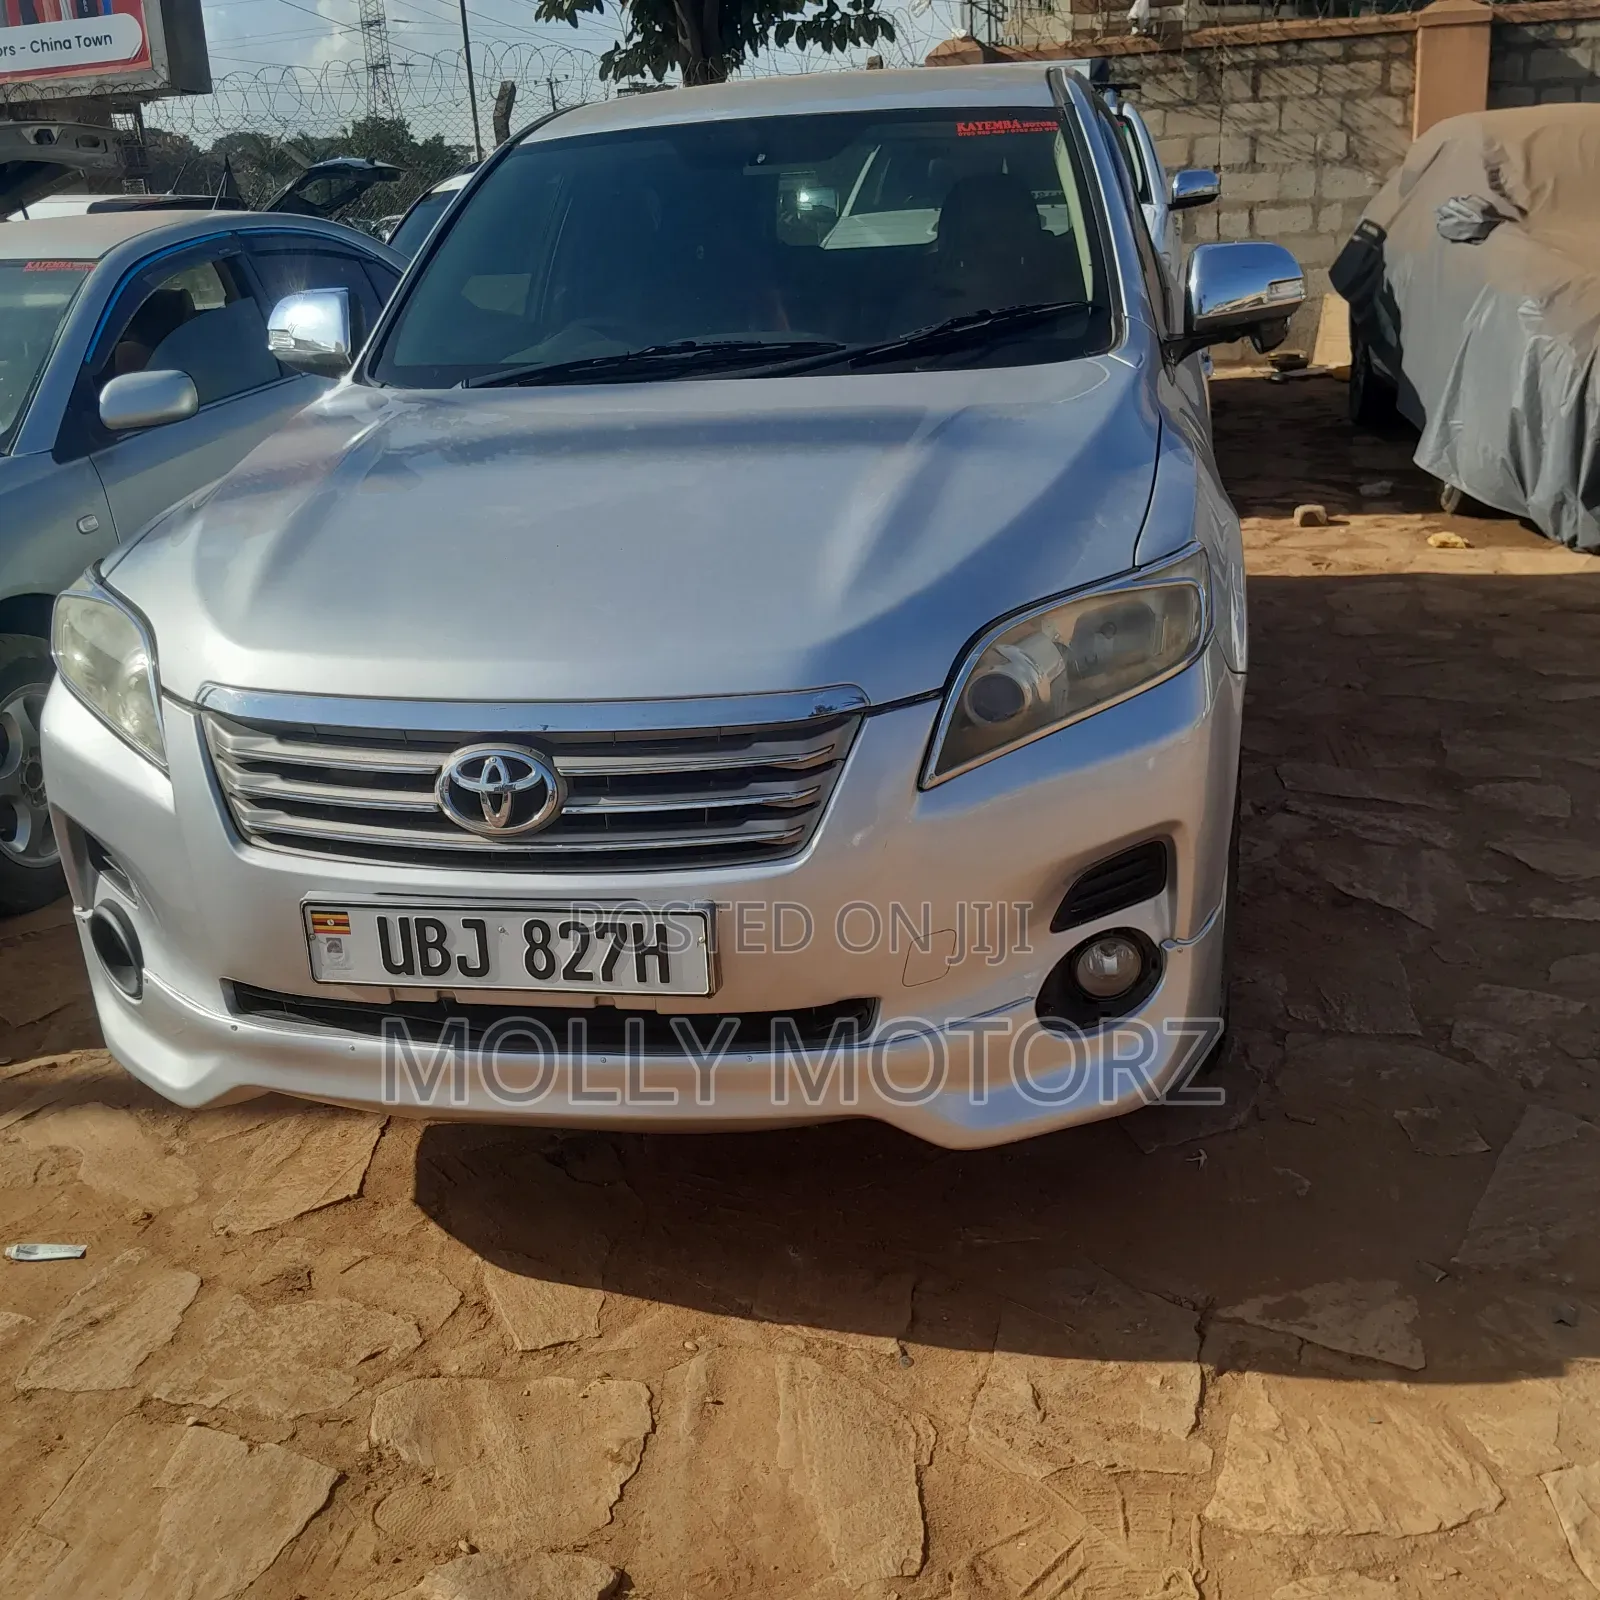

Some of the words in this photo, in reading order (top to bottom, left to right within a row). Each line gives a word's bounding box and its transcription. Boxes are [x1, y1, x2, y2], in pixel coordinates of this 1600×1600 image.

[0, 45, 16, 57] rs
[30, 37, 72, 53] China
[75, 34, 113, 48] Town
[376, 915, 491, 978] UBJ
[522, 919, 671, 984] 827H
